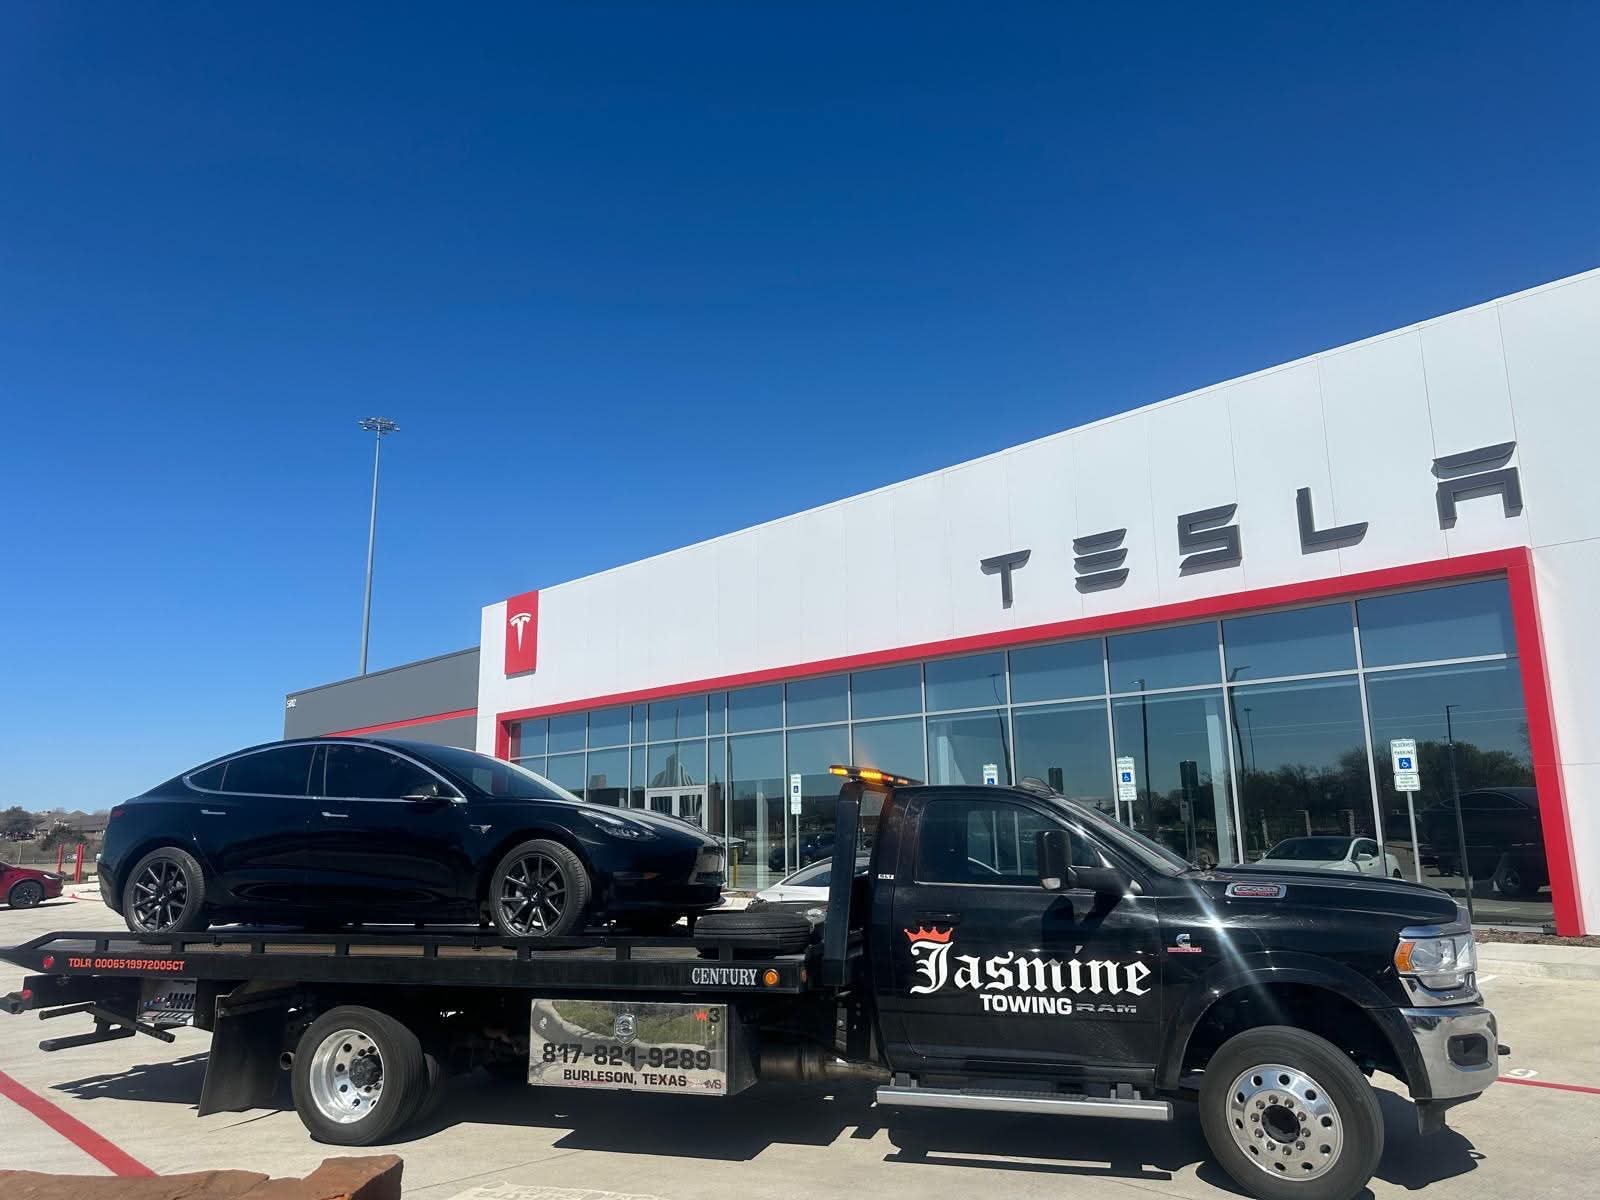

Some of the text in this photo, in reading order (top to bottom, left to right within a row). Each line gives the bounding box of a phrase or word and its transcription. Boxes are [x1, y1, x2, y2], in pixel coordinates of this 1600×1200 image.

[980, 441, 1523, 610] TESLA
[68, 958, 92, 968] TDLR
[910, 941, 1152, 996] Jasmine
[691, 967, 758, 986] CENTURY
[979, 994, 1073, 1015] TOWING
[1076, 1002, 1138, 1014] RAM
[709, 1007, 721, 1024] 3
[542, 1042, 712, 1071] 817-821-9289
[563, 1069, 688, 1087] BURLESON, TEXAS
